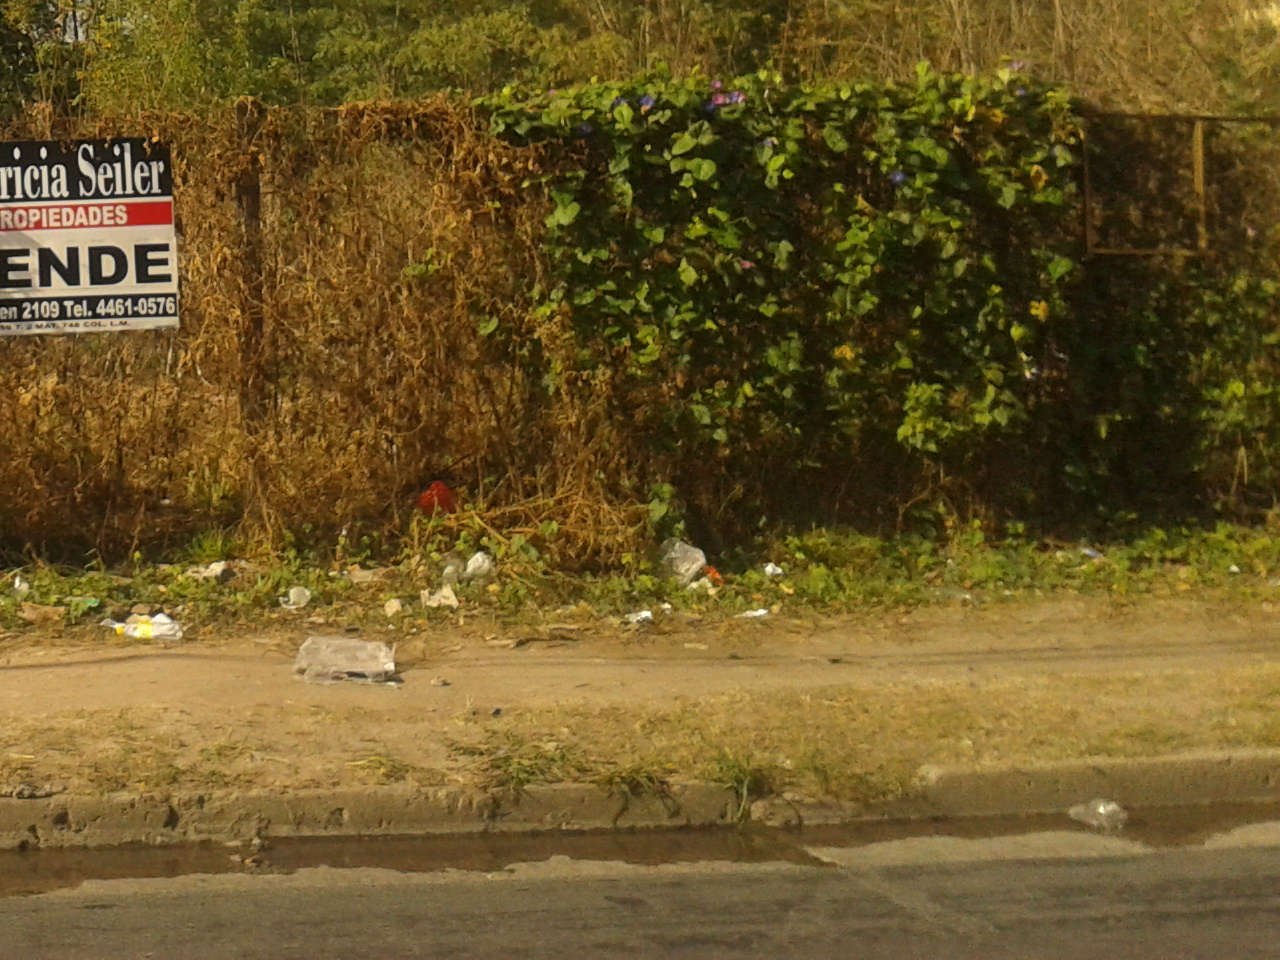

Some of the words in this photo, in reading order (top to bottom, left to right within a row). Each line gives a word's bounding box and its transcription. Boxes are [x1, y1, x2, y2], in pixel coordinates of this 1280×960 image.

[77, 142, 165, 197] Seiler
[21, 301, 60, 320] 2109
[63, 299, 93, 318] Tel.
[96, 297, 176, 316] 4461-0576
